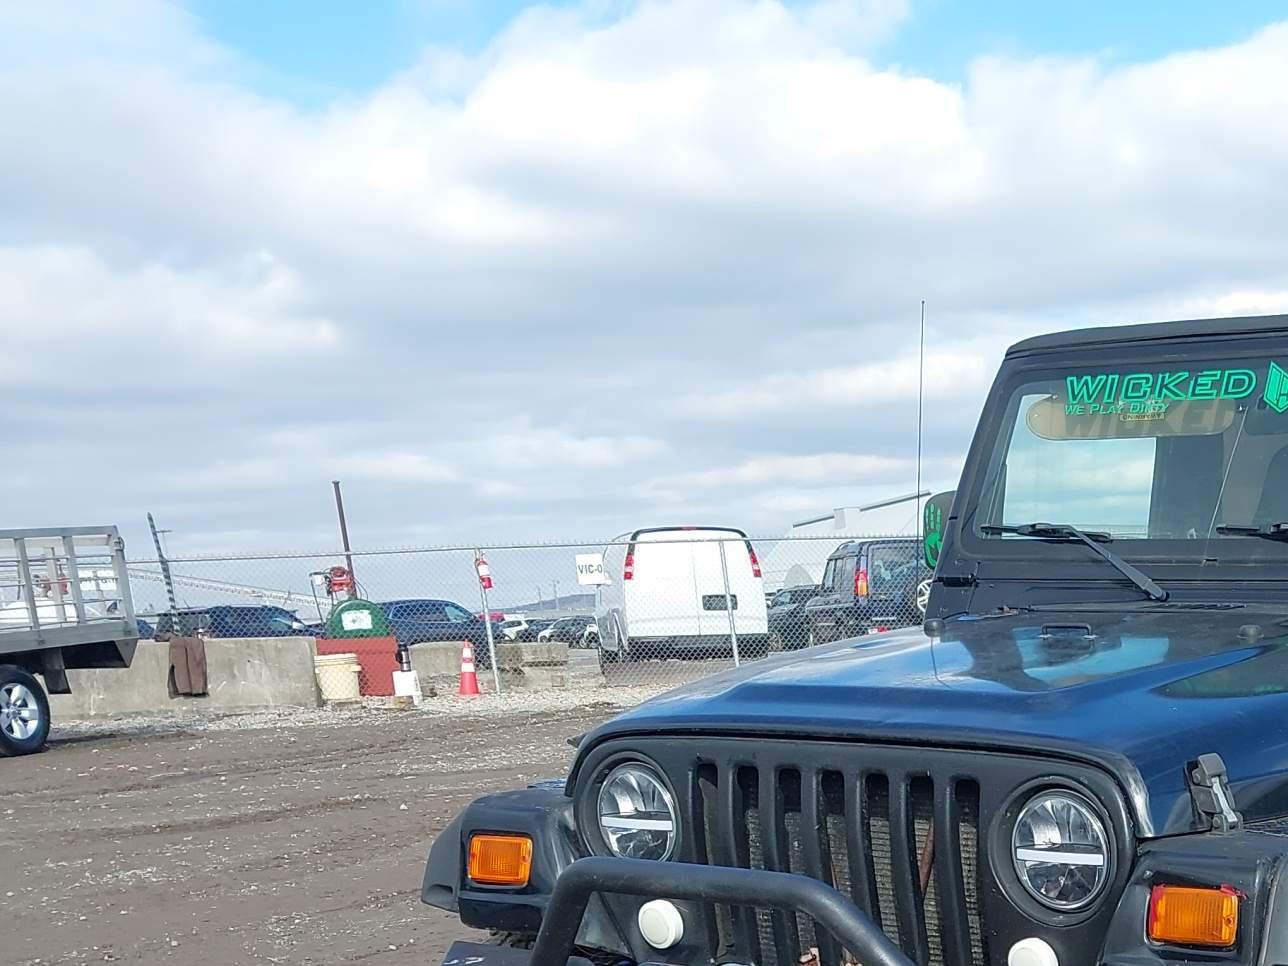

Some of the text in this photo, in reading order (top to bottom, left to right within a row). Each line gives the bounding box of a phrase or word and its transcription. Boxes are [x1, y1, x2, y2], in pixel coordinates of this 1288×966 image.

[1066, 369, 1256, 404] WICKED
[1065, 404, 1085, 416] WE
[1090, 399, 1125, 415] PLAY
